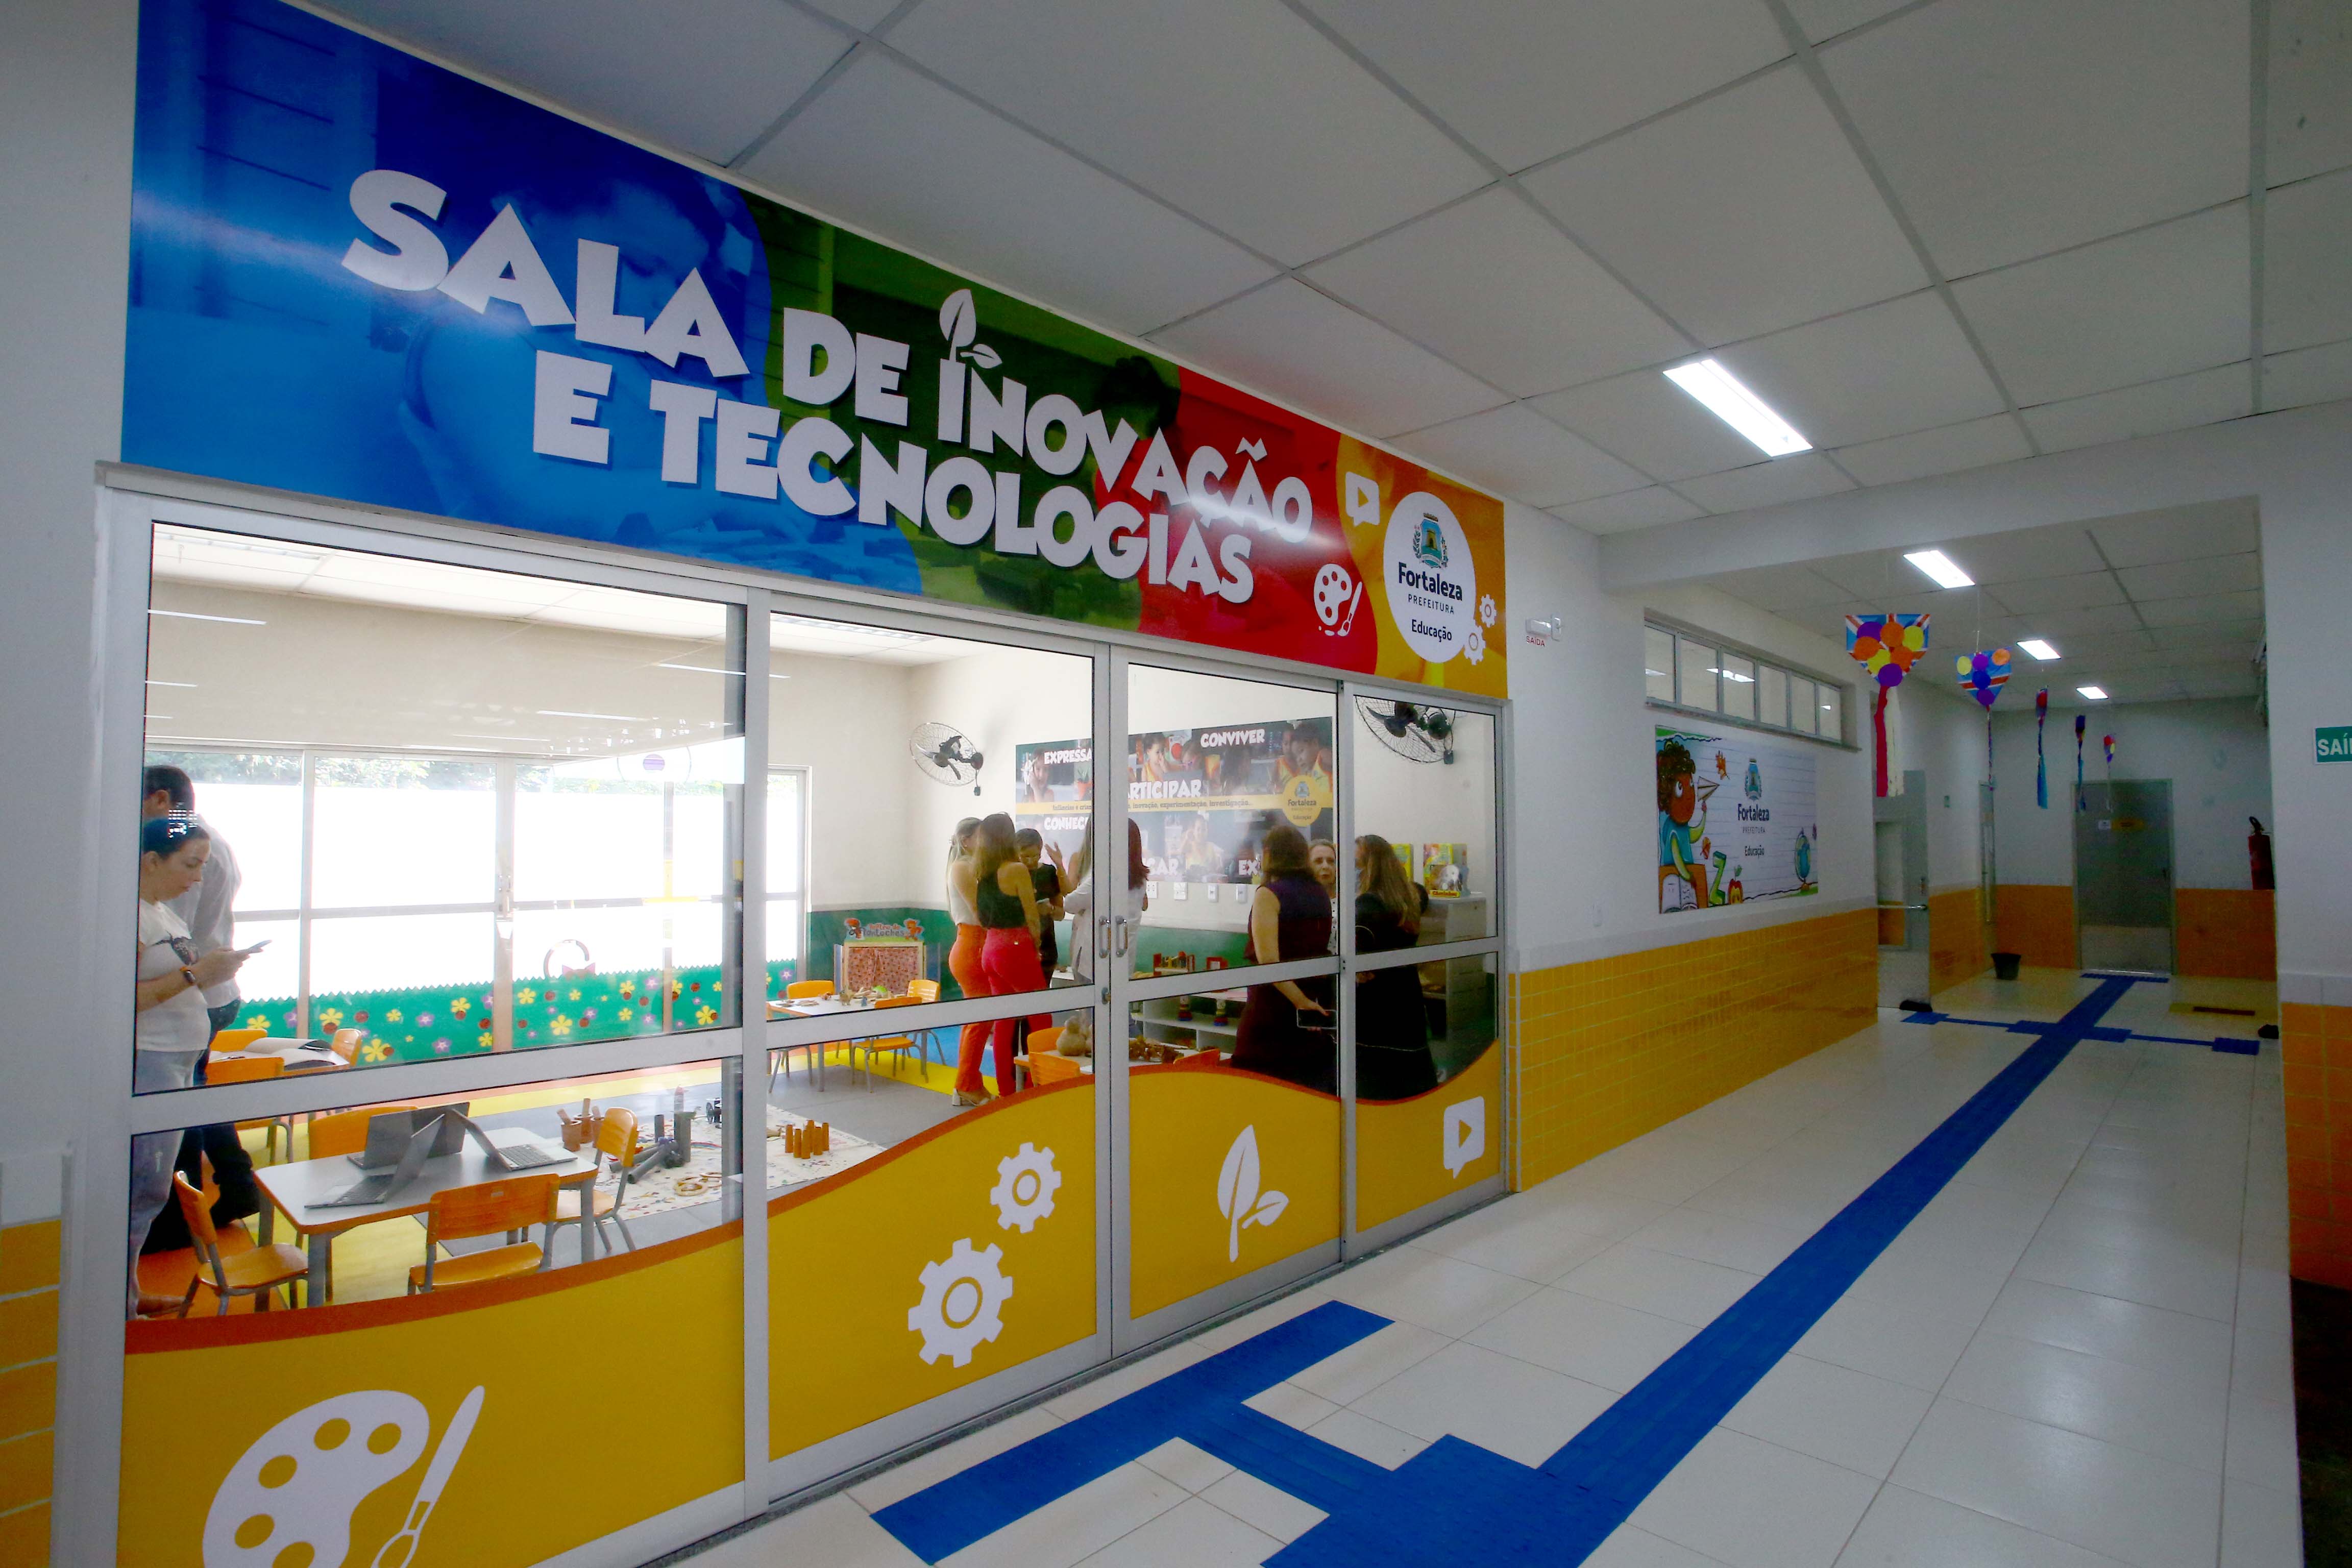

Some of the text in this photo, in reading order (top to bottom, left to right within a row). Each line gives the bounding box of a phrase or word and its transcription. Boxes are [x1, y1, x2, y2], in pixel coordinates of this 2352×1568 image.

[341, 169, 1312, 543] SALA DE INOVAÇÃO
[533, 350, 1254, 603] E TECNOLOGIAS
[1399, 562, 1462, 601] Fortaleza
[1408, 594, 1454, 615] PREFEITURA
[1411, 619, 1452, 642] Educação
[1200, 729, 1265, 748] CONVIVER
[1128, 779, 1202, 800] RTICIPAR
[1737, 803, 1770, 821] Fortaleza
[1745, 845, 1765, 859] Educação
